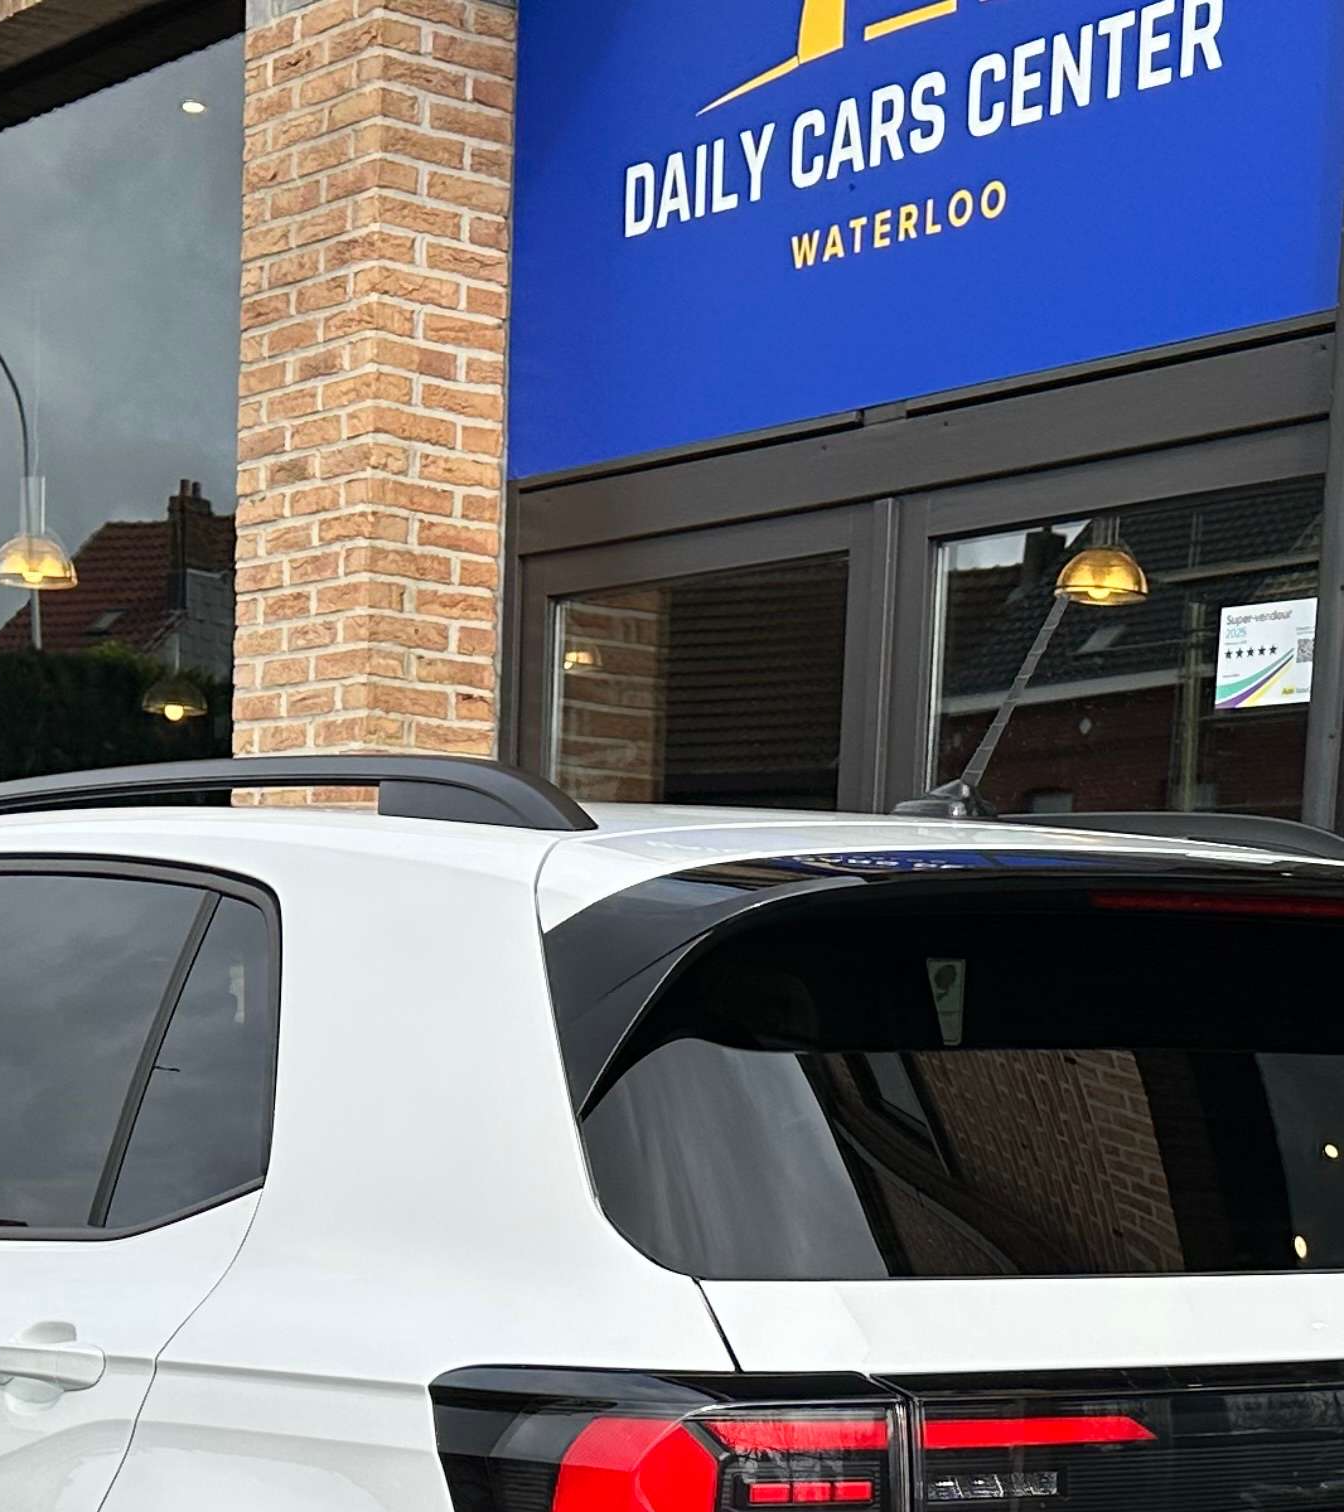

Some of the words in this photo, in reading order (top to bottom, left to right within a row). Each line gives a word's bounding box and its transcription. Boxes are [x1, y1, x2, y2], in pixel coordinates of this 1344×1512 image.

[623, 121, 776, 239] DAILY
[790, 70, 946, 190] CARS
[967, 0, 1224, 139] CENTER
[791, 179, 1008, 270] WATERLOO
